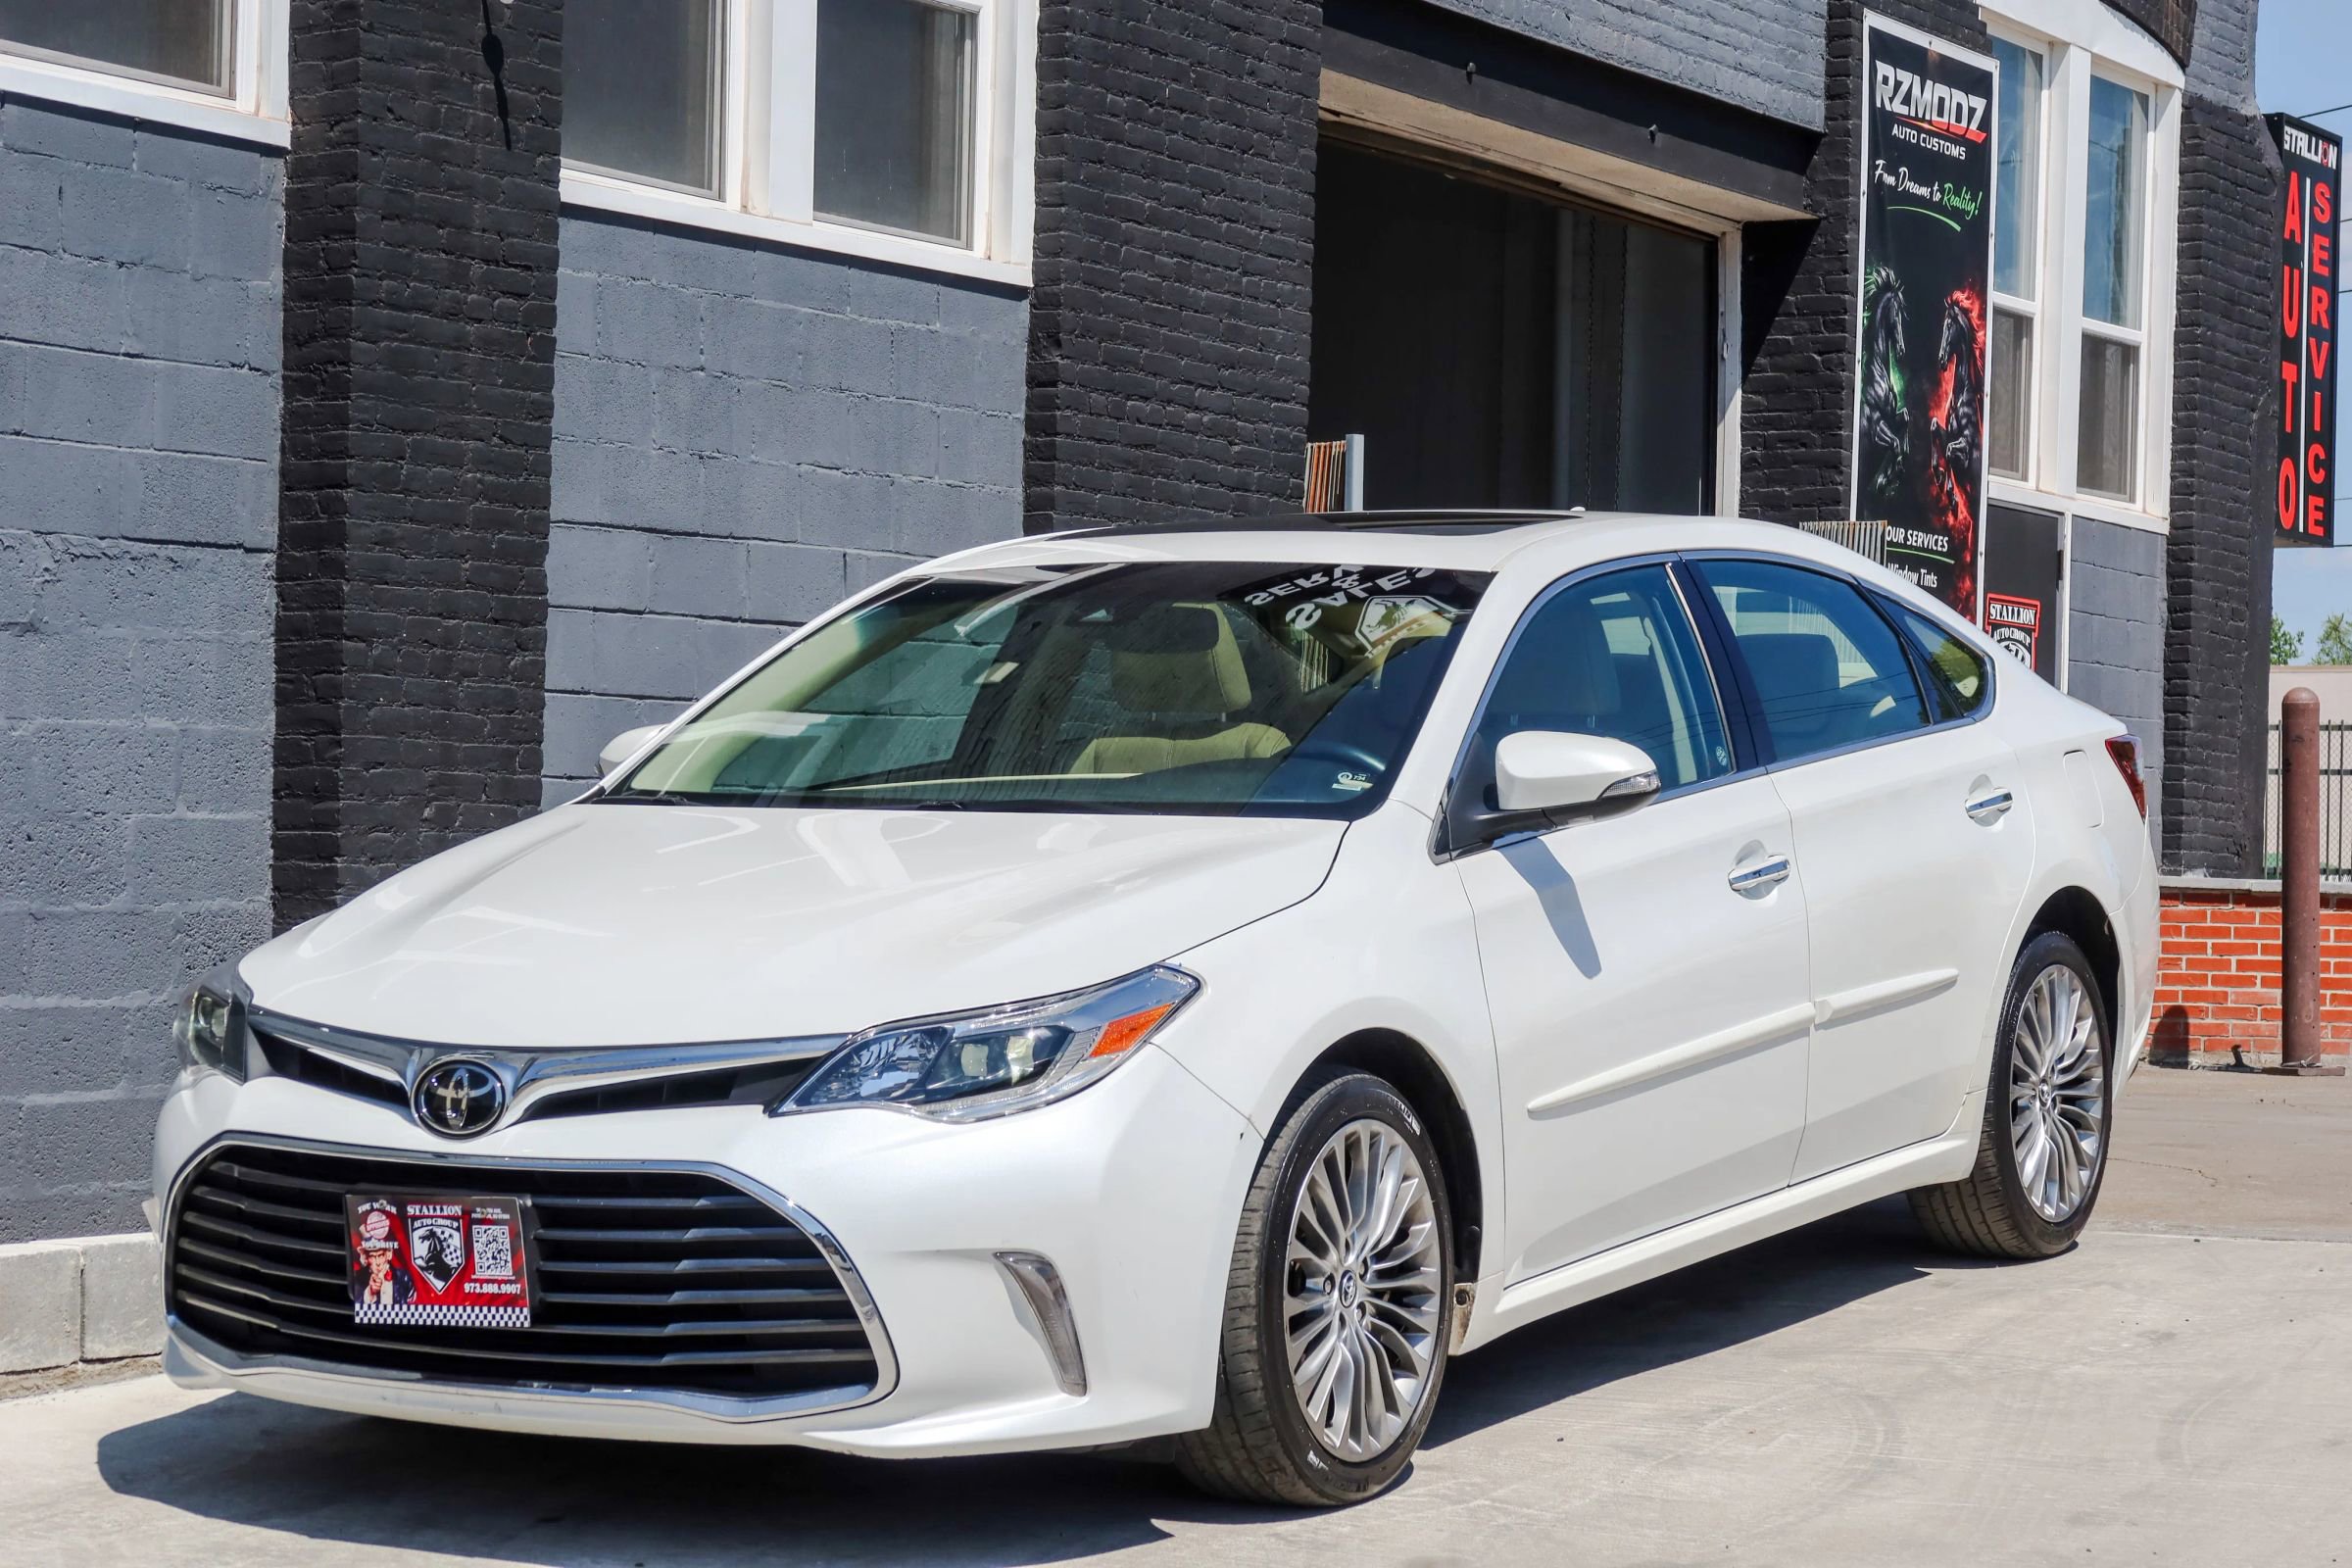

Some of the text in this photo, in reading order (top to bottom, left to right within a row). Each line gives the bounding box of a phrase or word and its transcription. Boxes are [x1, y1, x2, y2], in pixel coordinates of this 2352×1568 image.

[1875, 60, 1987, 143] RZMODZ
[1891, 123, 1966, 160] AUTO CUSTOMS
[2283, 125, 2338, 170] STALLION
[1874, 159, 1983, 220] From Dreams to Reality!
[2278, 171, 2302, 530] AUTO
[2307, 182, 2332, 536] SERVICE
[1886, 525, 1949, 553] OUR SERVICES
[1920, 567, 1937, 588] Tints
[1989, 603, 2036, 626] STALLION
[1992, 627, 2032, 647] AUTO GROUP
[407, 1204, 463, 1216] STALLION
[413, 1218, 459, 1229] AUTO GROUP
